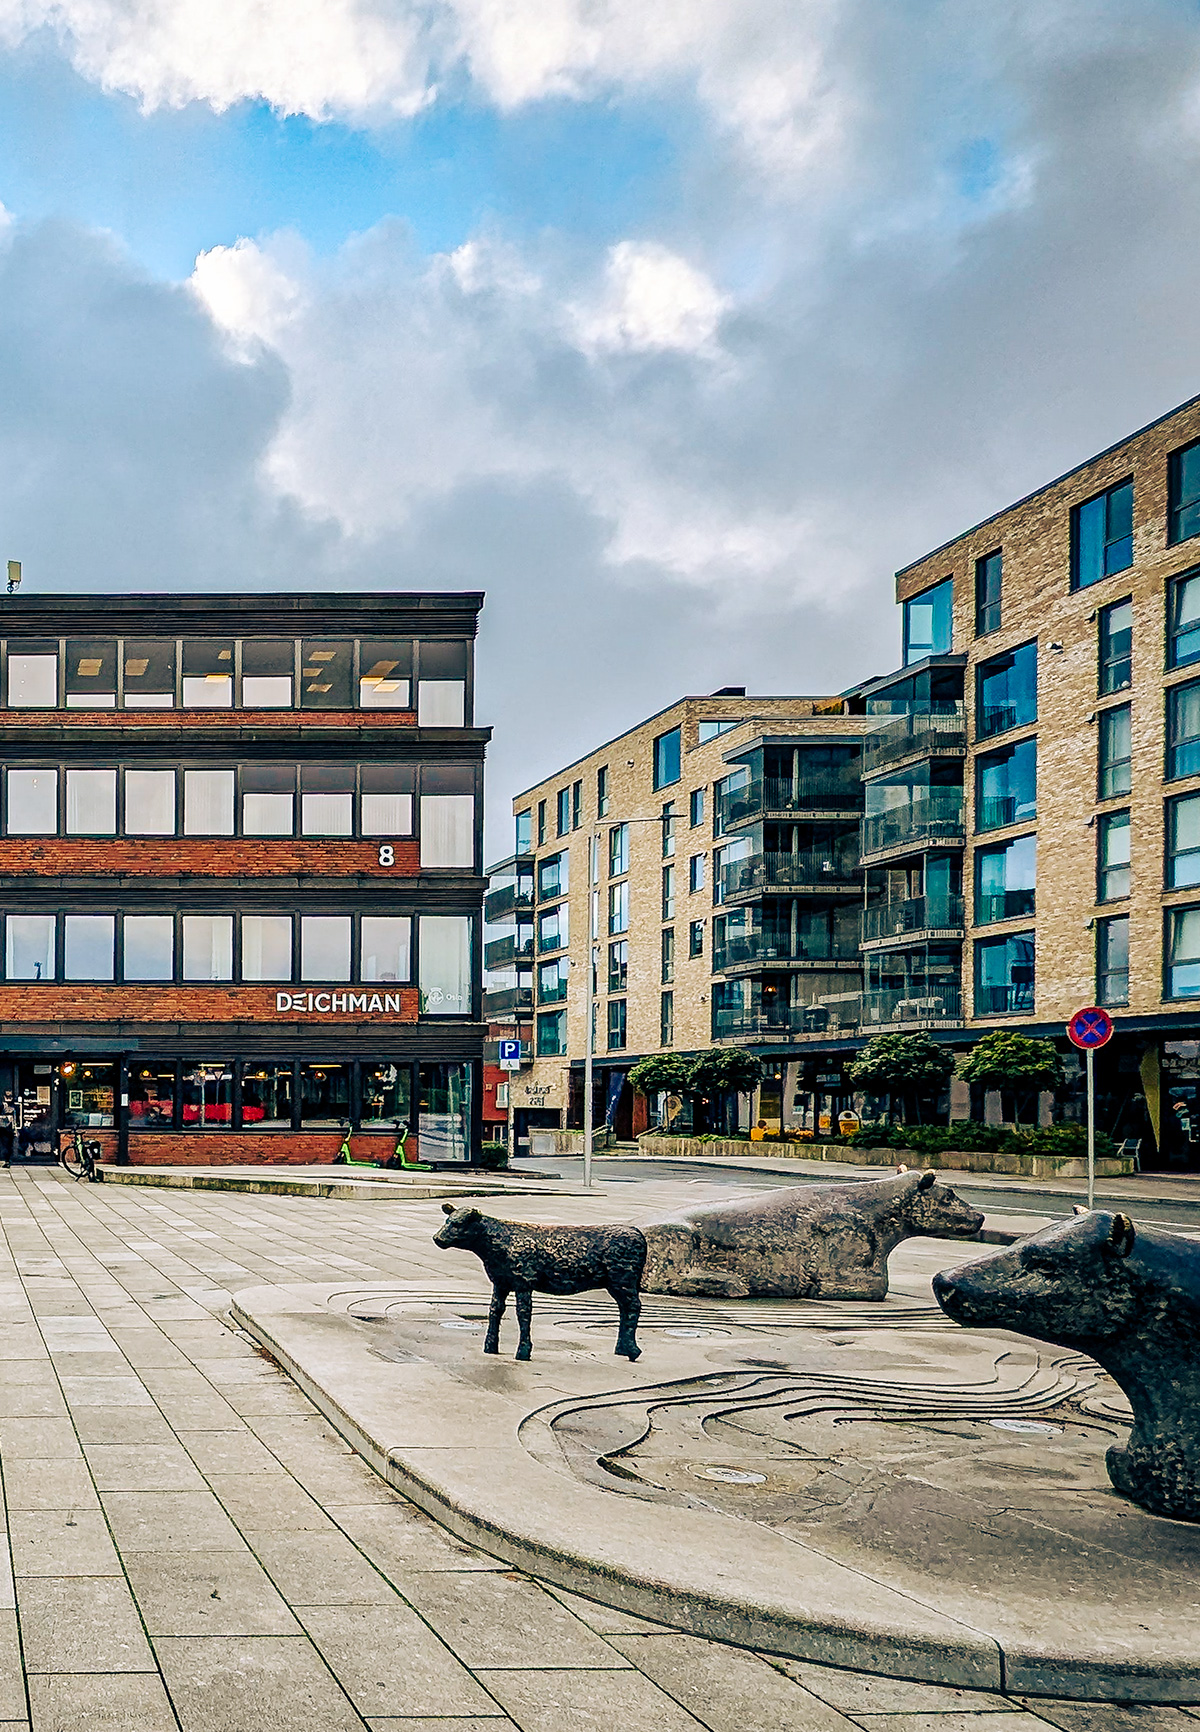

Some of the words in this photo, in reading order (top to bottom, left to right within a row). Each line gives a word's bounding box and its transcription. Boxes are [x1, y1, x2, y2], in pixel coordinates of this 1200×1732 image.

[378, 845, 395, 866] 8
[276, 993, 400, 1012] DEICHMAN
[504, 1042, 516, 1057] P
